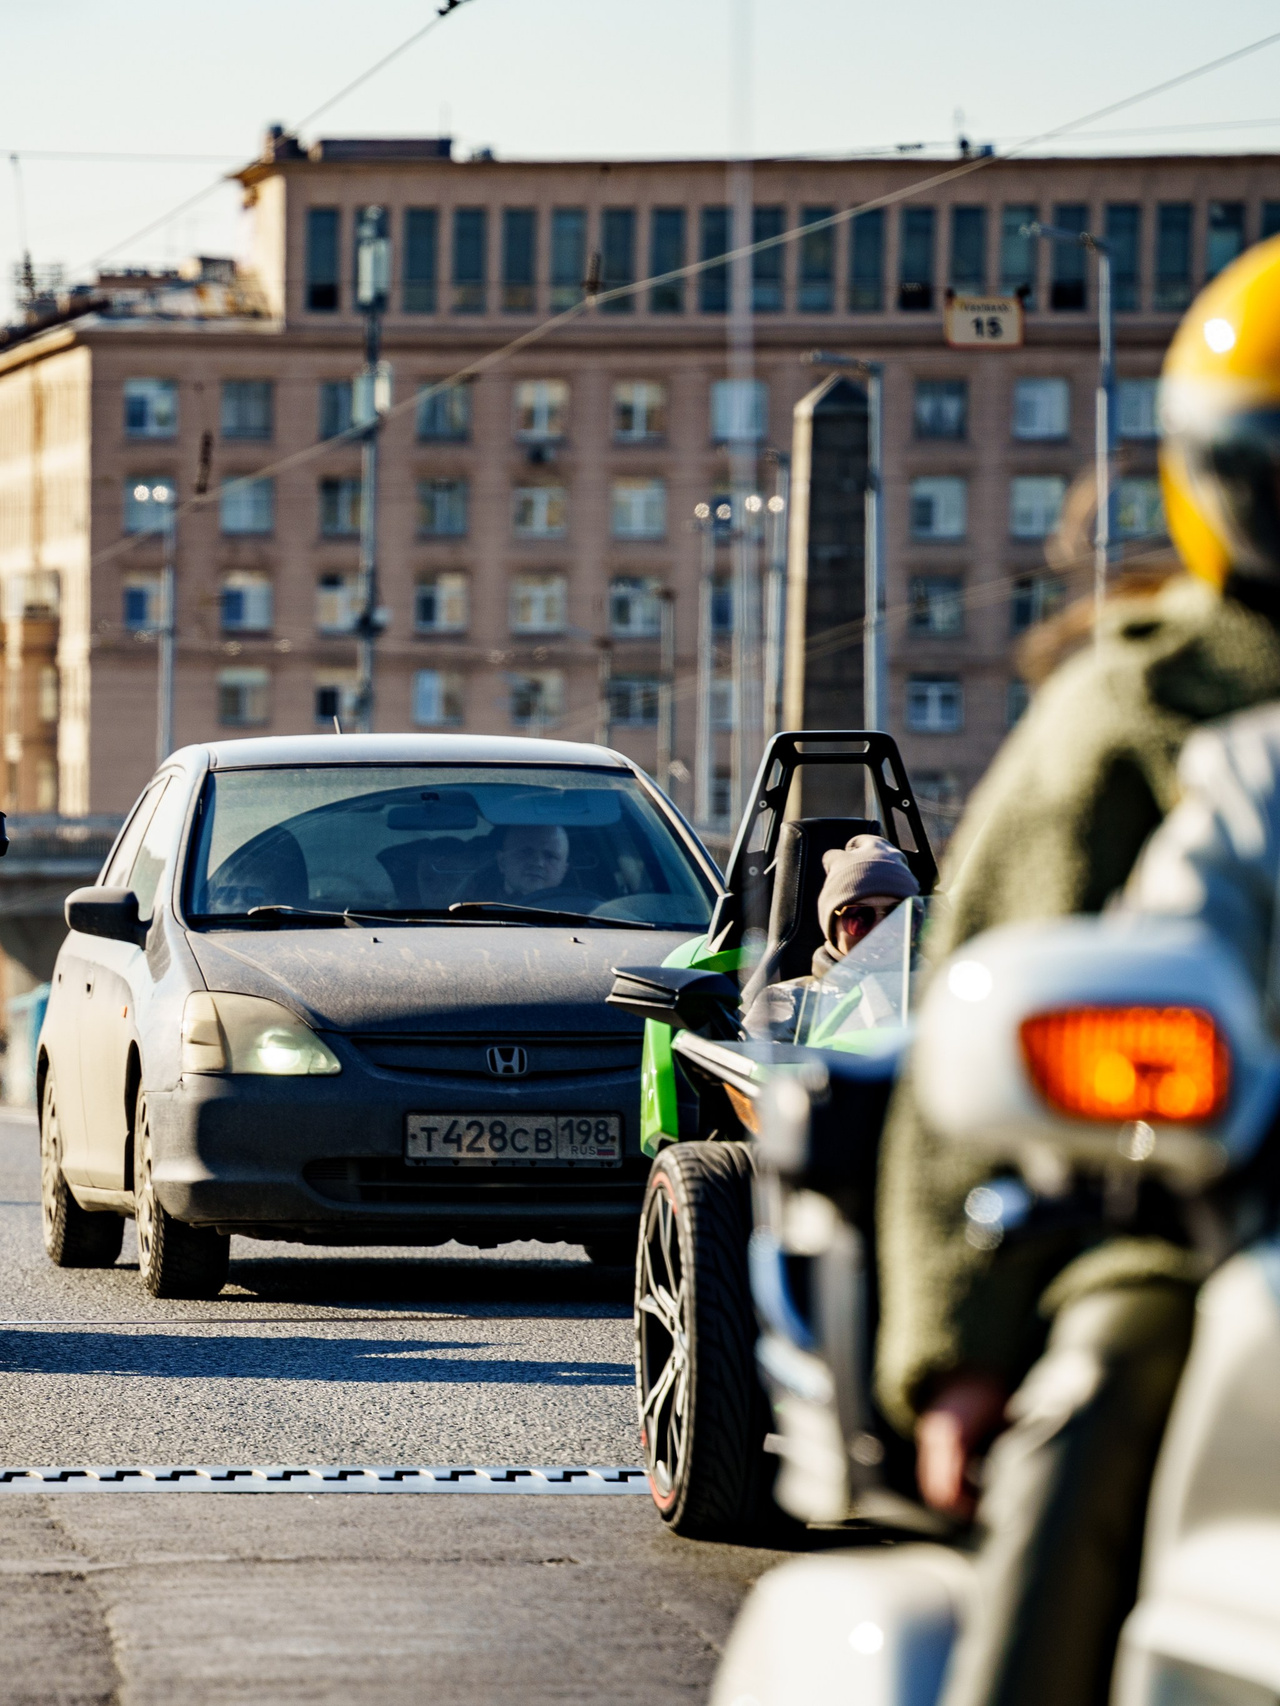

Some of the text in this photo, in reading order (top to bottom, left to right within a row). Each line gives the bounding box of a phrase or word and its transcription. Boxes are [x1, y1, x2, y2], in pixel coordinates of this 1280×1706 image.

[420, 1119, 610, 1153] Т428СВ 198
[571, 1146, 596, 1156] RUS
